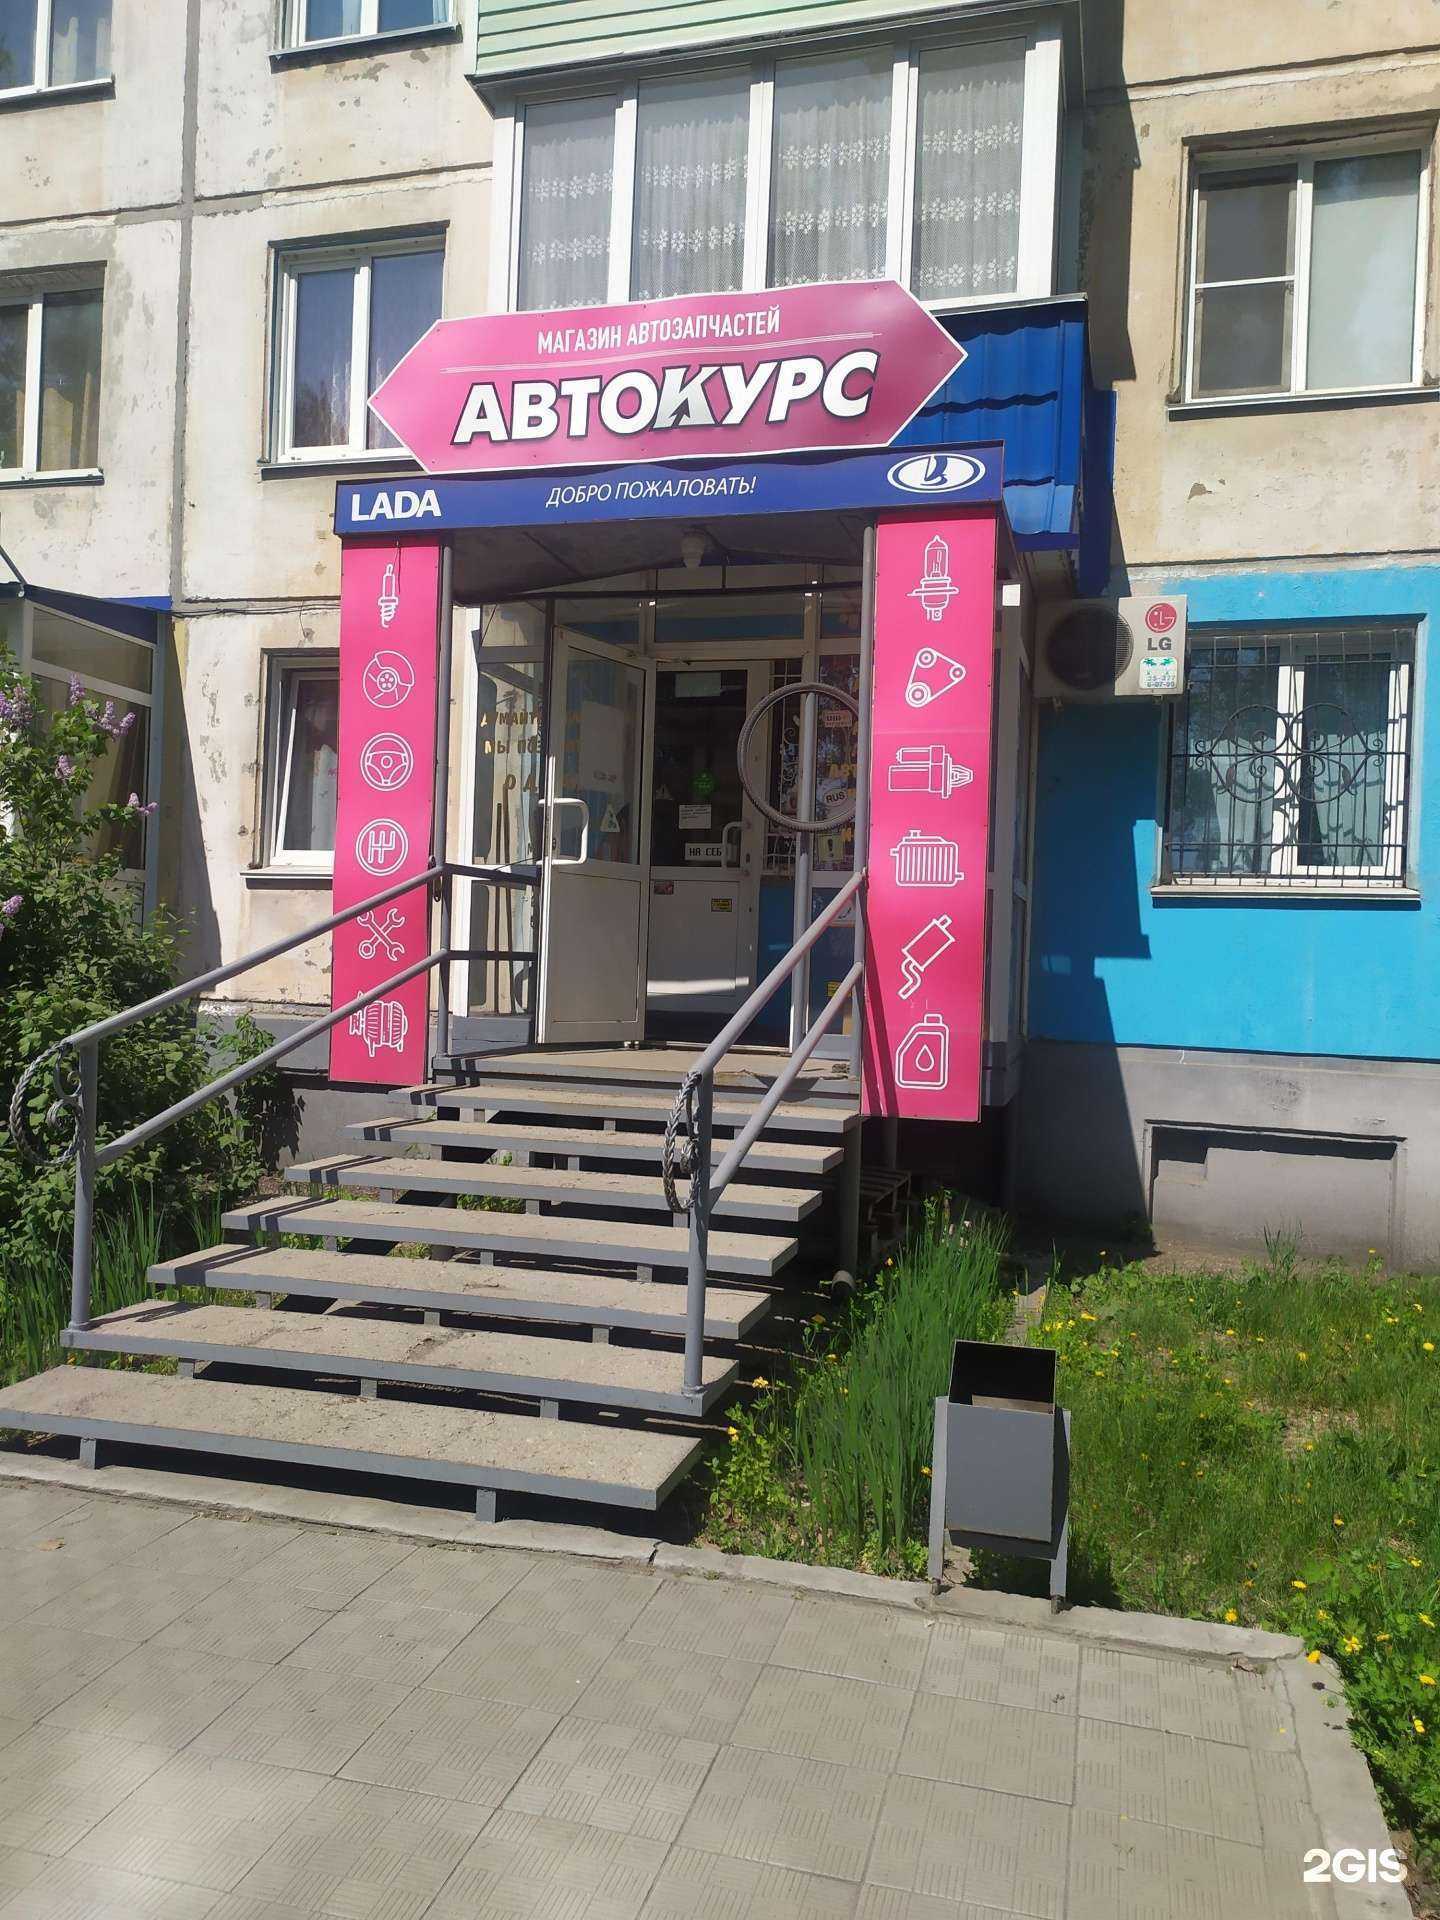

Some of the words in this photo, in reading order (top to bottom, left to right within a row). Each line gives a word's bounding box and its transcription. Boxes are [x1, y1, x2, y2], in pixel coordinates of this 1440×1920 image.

[537, 324, 622, 354] МАГАЗИН
[626, 304, 781, 346] АВТОЗАПЧАСТЕЙ
[450, 349, 881, 446] АВТОКУРС
[351, 489, 442, 522] LADA
[545, 484, 612, 508] ДОБРО
[615, 476, 758, 502] ПОЖАЛОВАТЬ!
[1147, 637, 1172, 651] LG
[826, 791, 846, 804] RUS
[689, 847, 701, 857] НА
[705, 847, 724, 857] СЕБ
